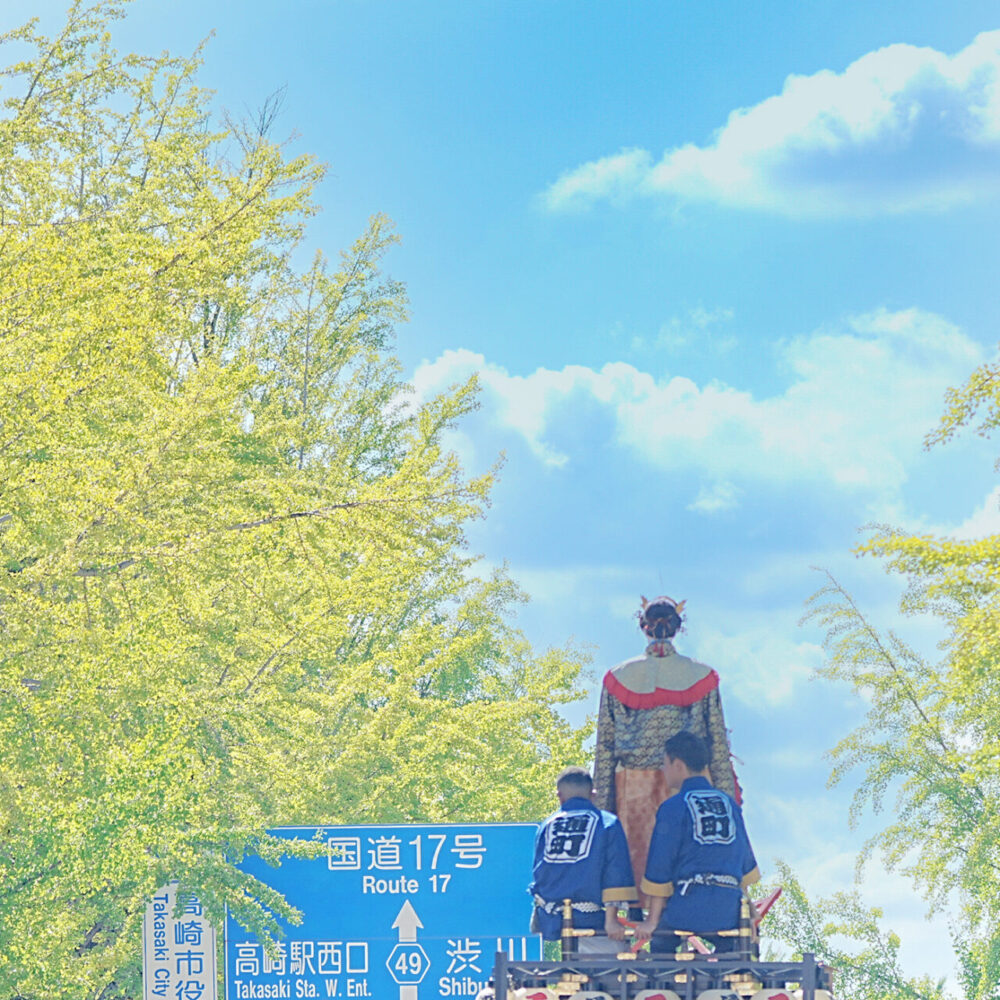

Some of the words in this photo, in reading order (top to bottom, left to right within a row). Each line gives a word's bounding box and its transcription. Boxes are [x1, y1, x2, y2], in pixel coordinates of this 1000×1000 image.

[328, 834, 487, 871] 国道17号
[363, 876, 419, 894] Route
[429, 875, 451, 893] 17
[153, 894, 169, 960] Takasaki
[235, 941, 369, 976] 高崎駅西口
[395, 952, 421, 975] 49
[152, 968, 170, 997] City
[234, 978, 290, 999] Takasaki
[296, 978, 320, 998] Sta.
[325, 978, 342, 997] W.
[347, 978, 372, 997] Ent.
